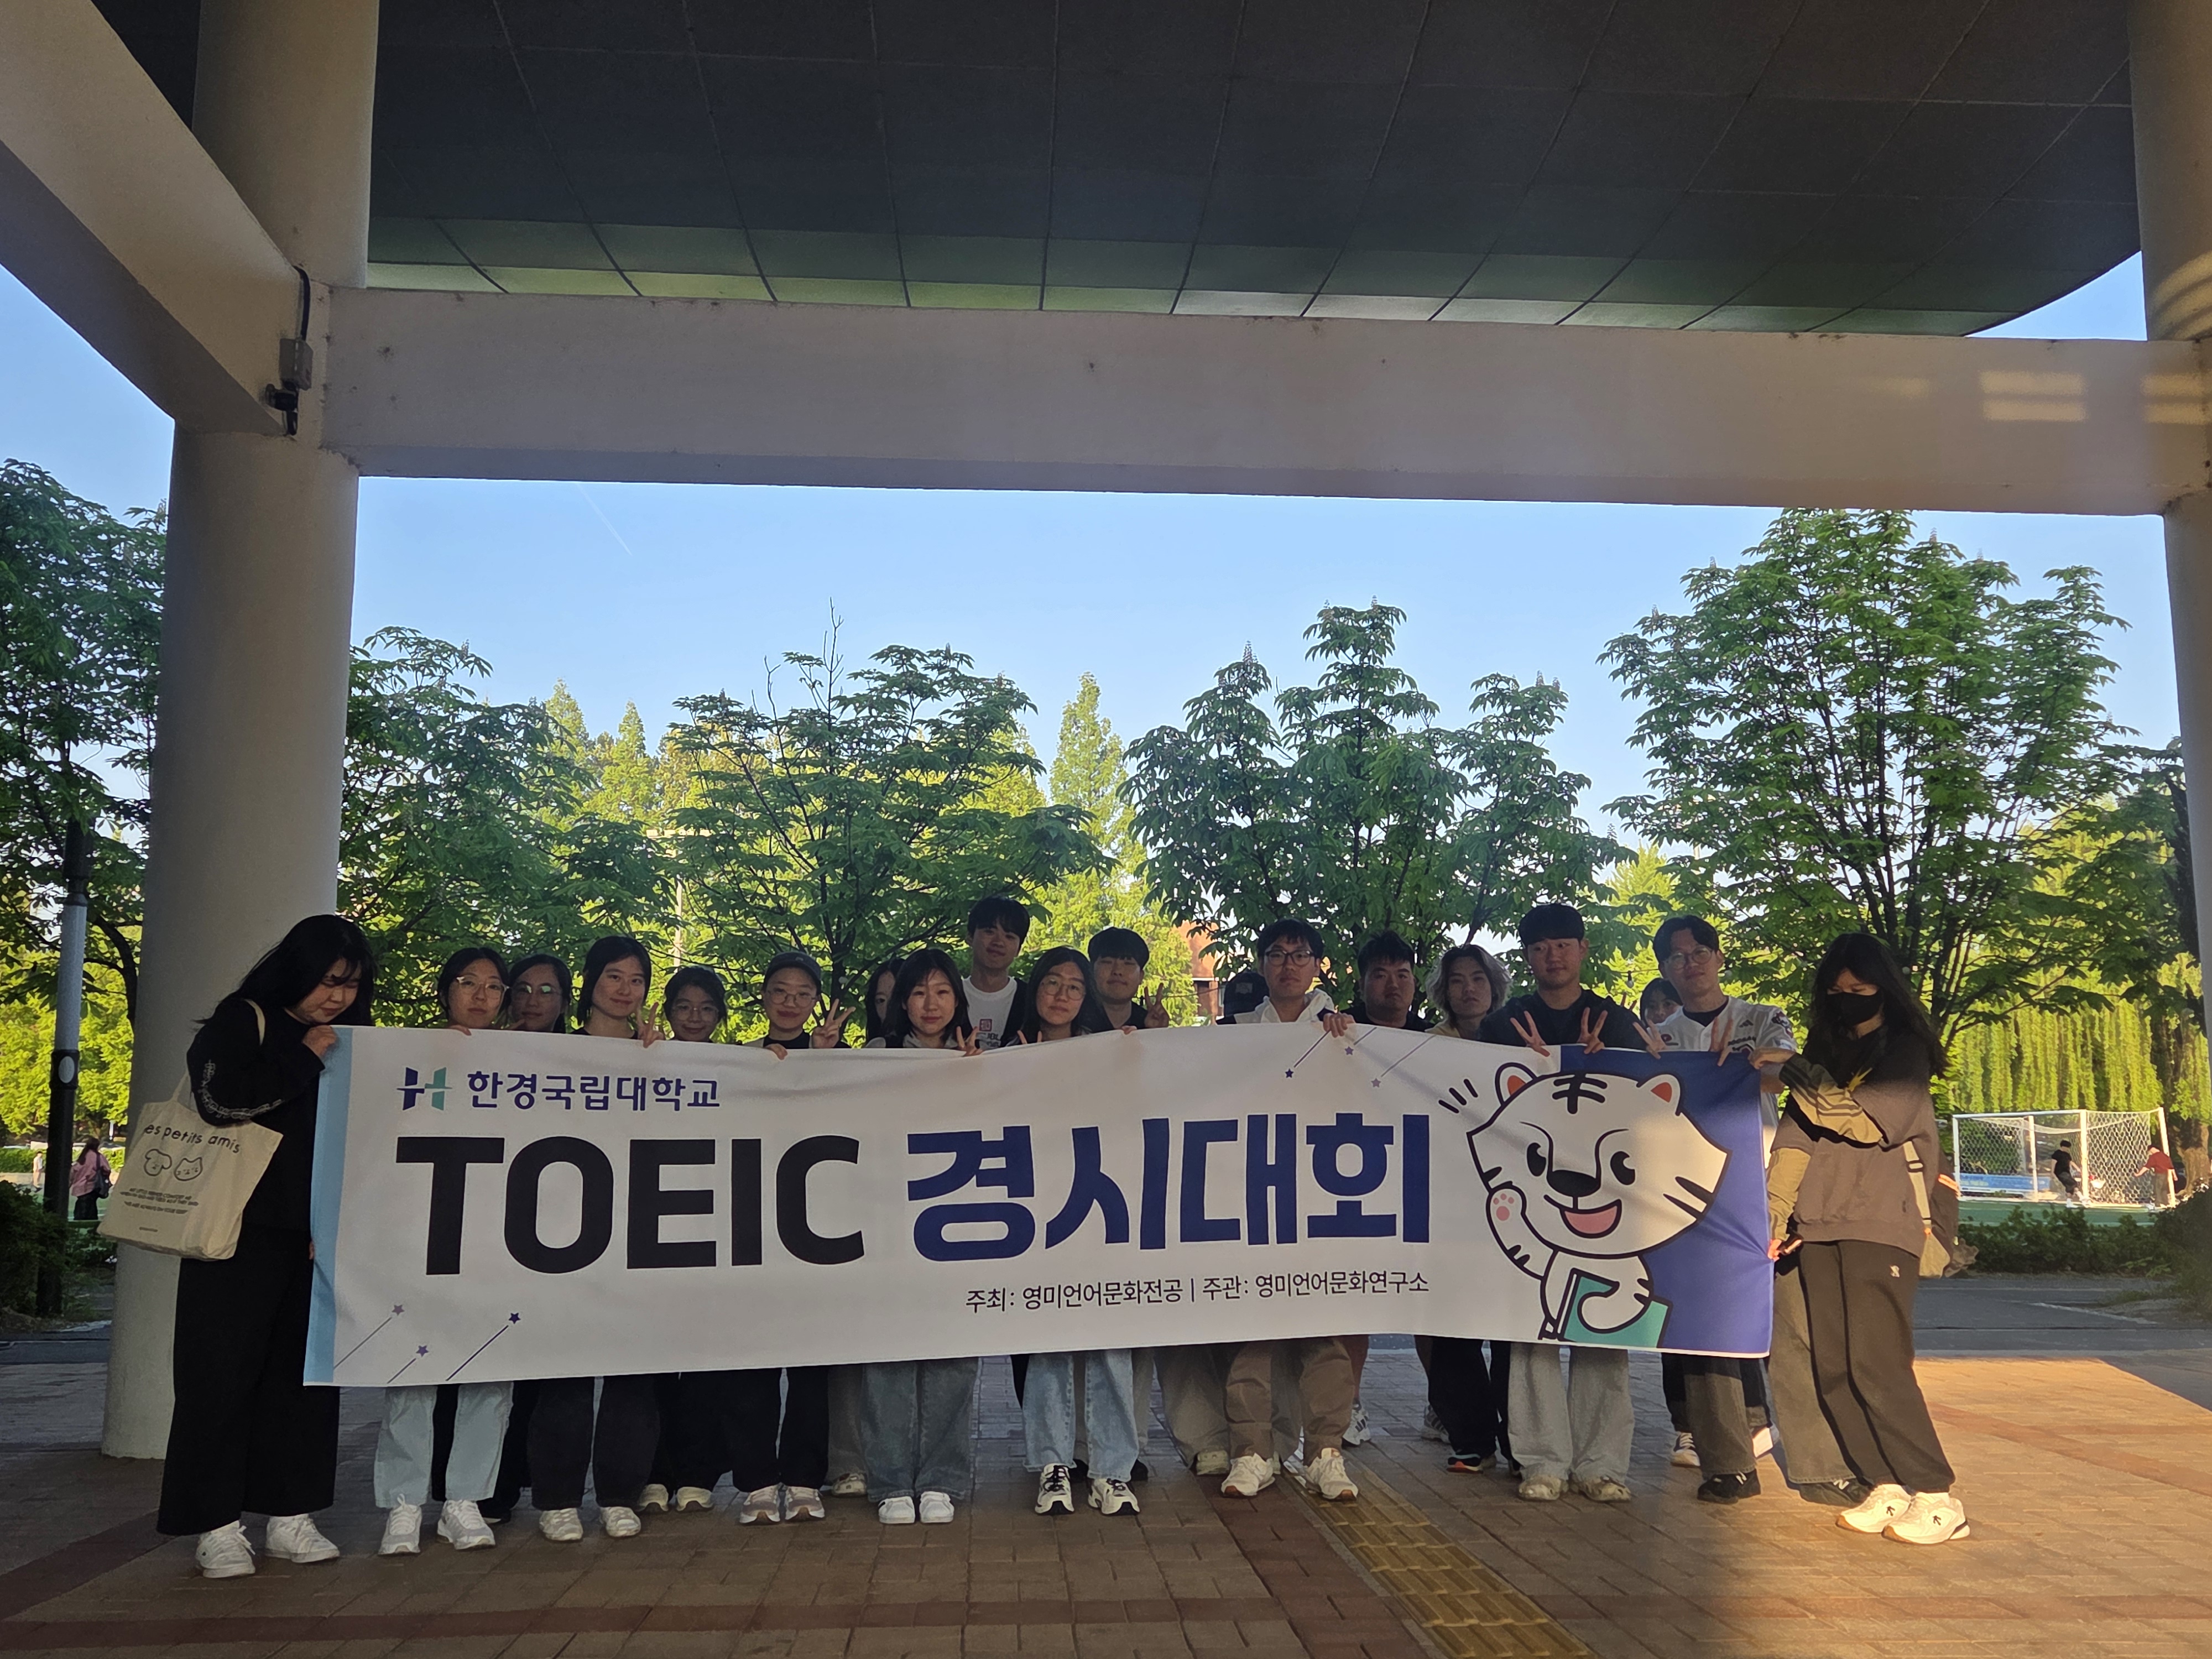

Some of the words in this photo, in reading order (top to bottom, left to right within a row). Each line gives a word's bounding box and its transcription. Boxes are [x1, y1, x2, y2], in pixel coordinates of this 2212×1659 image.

[467, 1071, 721, 1112] 한경국립대학교
[161, 1127, 202, 1144] petits
[208, 1135, 240, 1154] amis
[395, 1135, 865, 1275] TOEIC
[907, 1112, 1430, 1262] 경시대회
[966, 1287, 1015, 1313] 주최:
[1022, 1279, 1184, 1310] 영미언어문화전공
[1202, 1275, 1249, 1301] 주관:
[1255, 1270, 1430, 1298] 영미언어문화연구소
